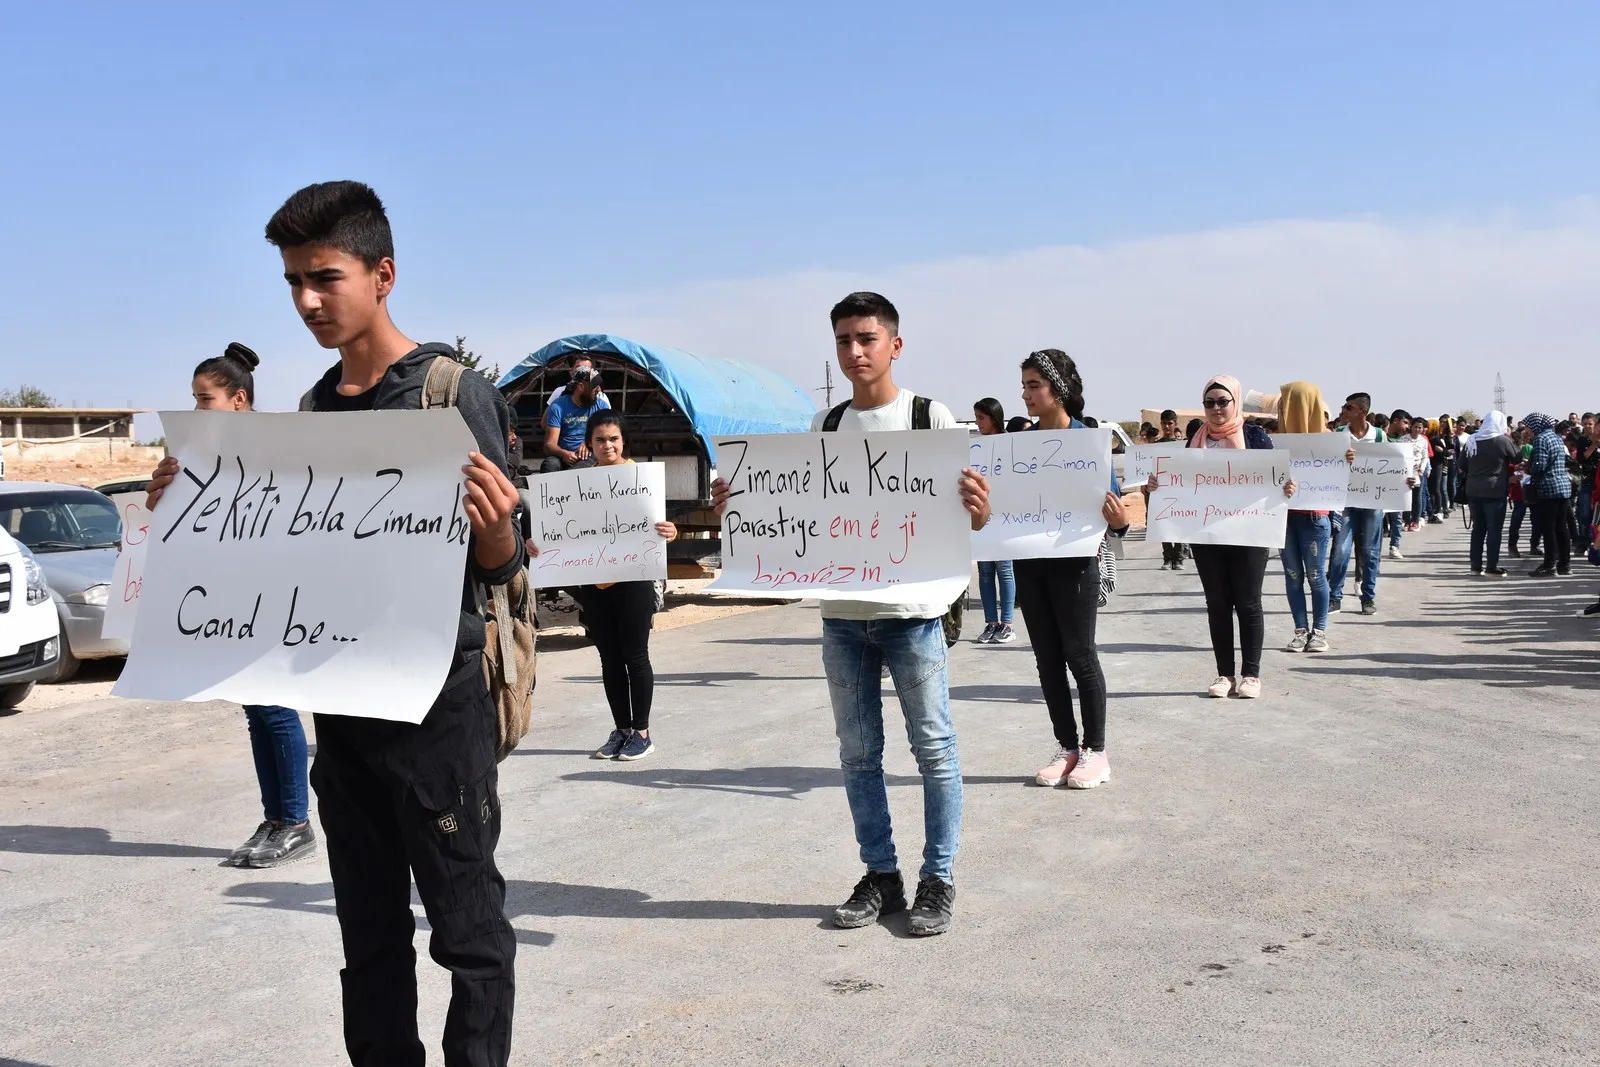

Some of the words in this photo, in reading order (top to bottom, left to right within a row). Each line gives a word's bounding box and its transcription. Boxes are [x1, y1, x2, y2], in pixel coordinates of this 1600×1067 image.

[864, 438, 937, 496] Kalan
[1042, 439, 1098, 472] Ziman
[1156, 456, 1184, 487] Em
[1194, 461, 1264, 495] penaberin
[287, 465, 345, 536] bila
[354, 468, 443, 540] Ziman
[540, 482, 571, 515] Heger
[1155, 497, 1197, 520] Ziman
